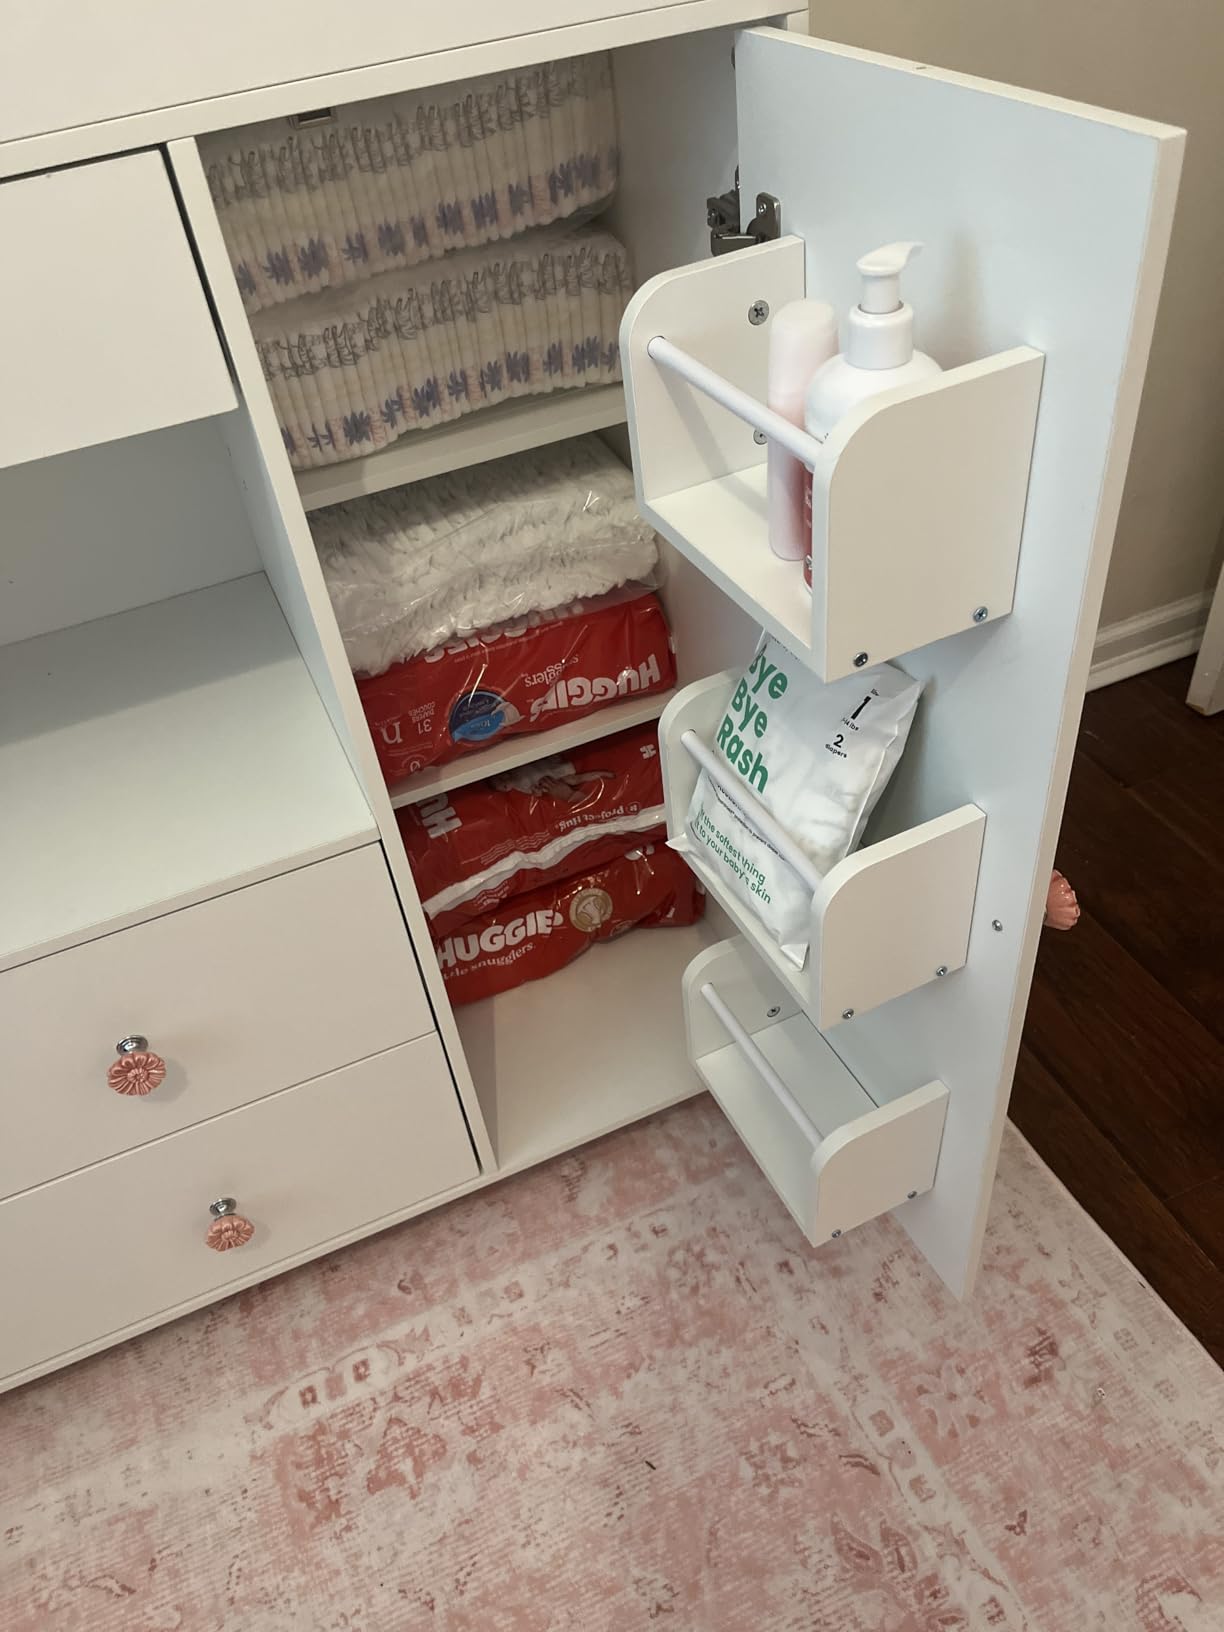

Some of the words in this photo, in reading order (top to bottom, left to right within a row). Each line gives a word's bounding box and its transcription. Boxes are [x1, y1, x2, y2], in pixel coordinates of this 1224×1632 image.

[524, 654, 579, 688] sgglers
[417, 718, 432, 735] 31
[731, 677, 768, 739] Bye
[850, 695, 872, 720] 1
[716, 713, 769, 794] Rash
[833, 733, 844, 749] 2
[700, 825, 706, 838] to
[706, 835, 723, 856] your
[750, 882, 772, 905] skin
[704, 815, 715, 833] the
[715, 830, 741, 861] softest
[742, 856, 766, 886] thing
